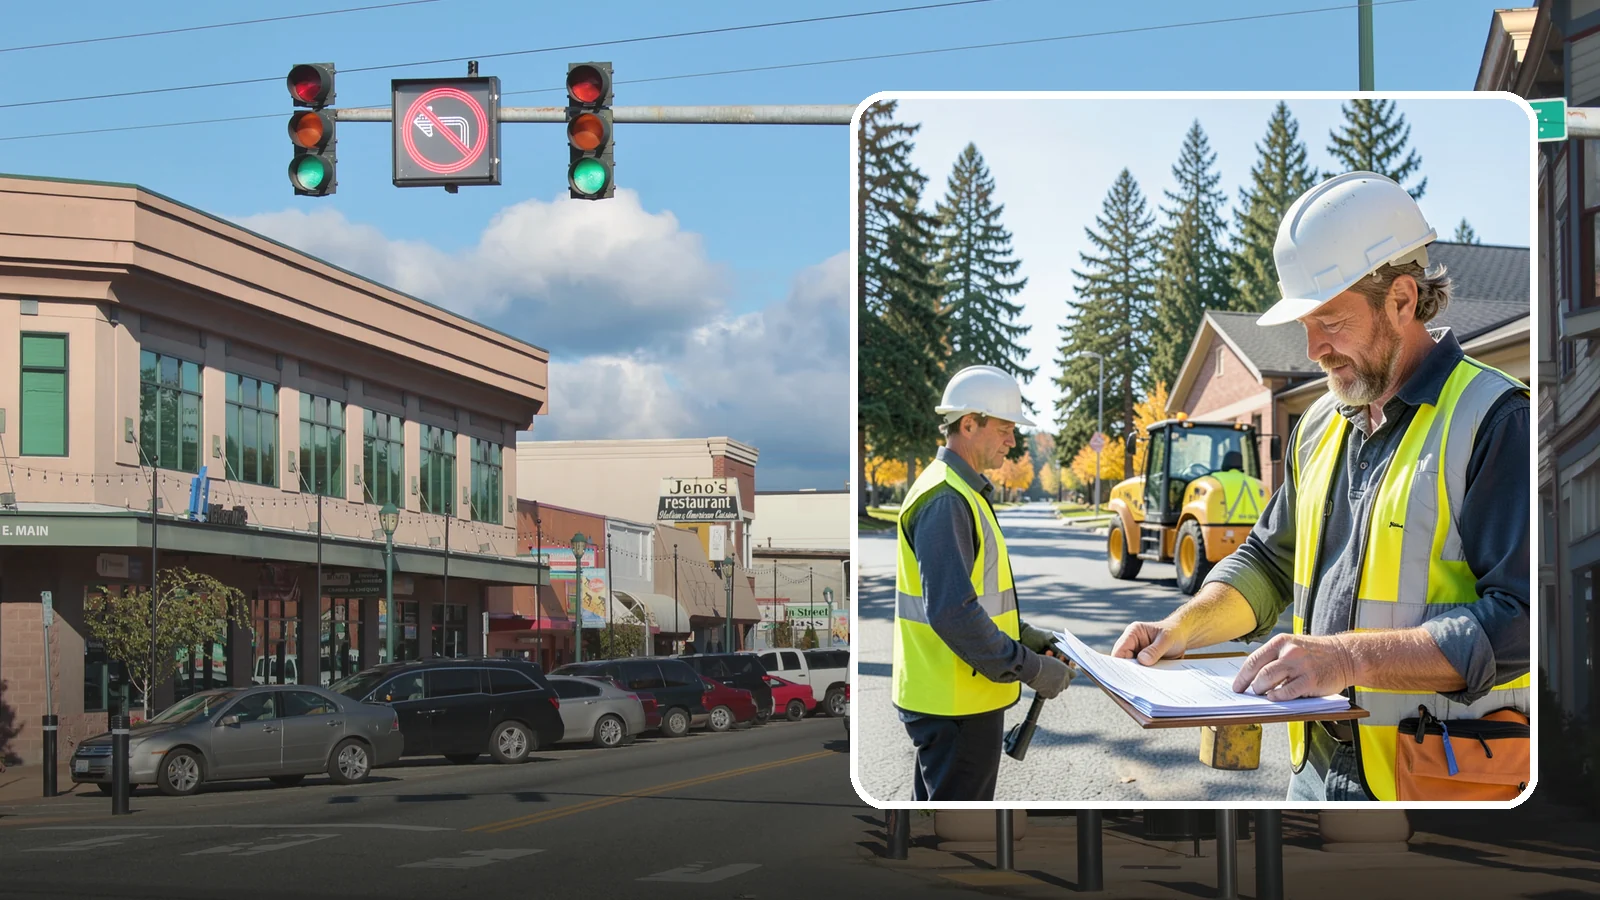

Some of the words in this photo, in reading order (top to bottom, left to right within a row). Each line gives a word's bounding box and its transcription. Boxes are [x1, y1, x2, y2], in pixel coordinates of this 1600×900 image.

[669, 480, 728, 494] Jeno's
[665, 496, 731, 509] restaurant
[659, 509, 682, 520] Italian
[686, 509, 714, 520] American
[715, 509, 737, 520] Cuisine
[2, 525, 13, 536] E.
[15, 525, 49, 536] MAIN
[797, 607, 828, 617] Street
